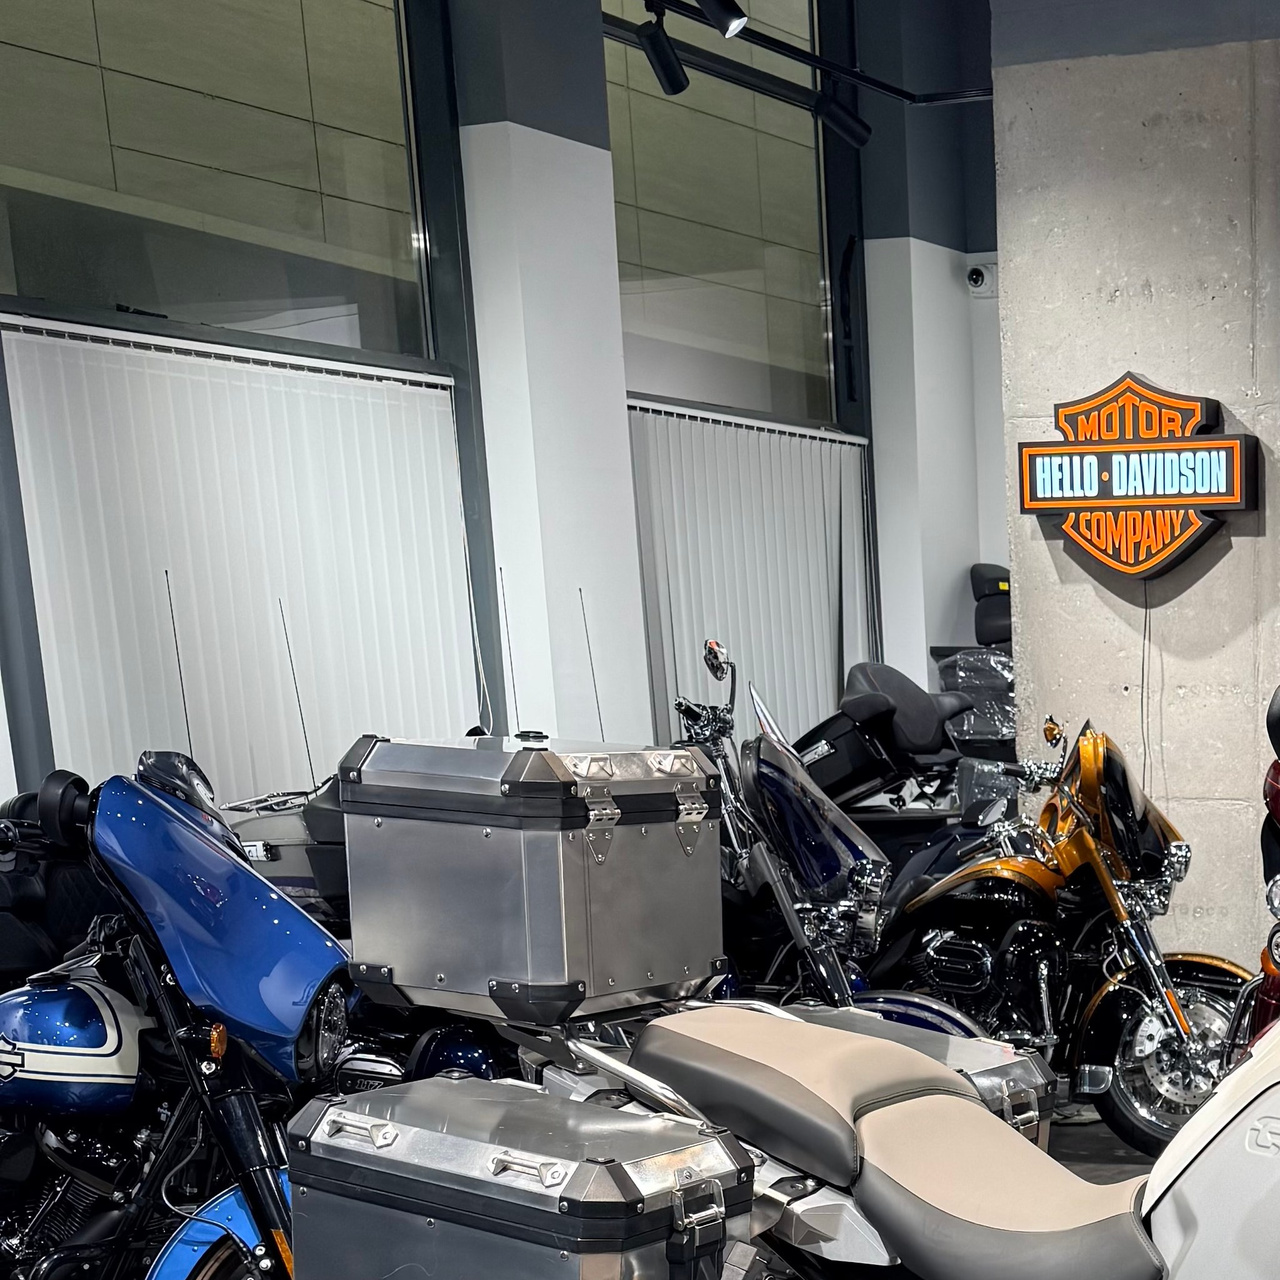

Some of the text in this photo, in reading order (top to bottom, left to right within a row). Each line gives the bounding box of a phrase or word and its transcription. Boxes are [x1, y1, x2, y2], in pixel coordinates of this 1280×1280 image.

[1077, 392, 1182, 441] MOTOR
[1035, 450, 1227, 498] HELLO DAVIDSON
[1079, 510, 1185, 564] COMPANY
